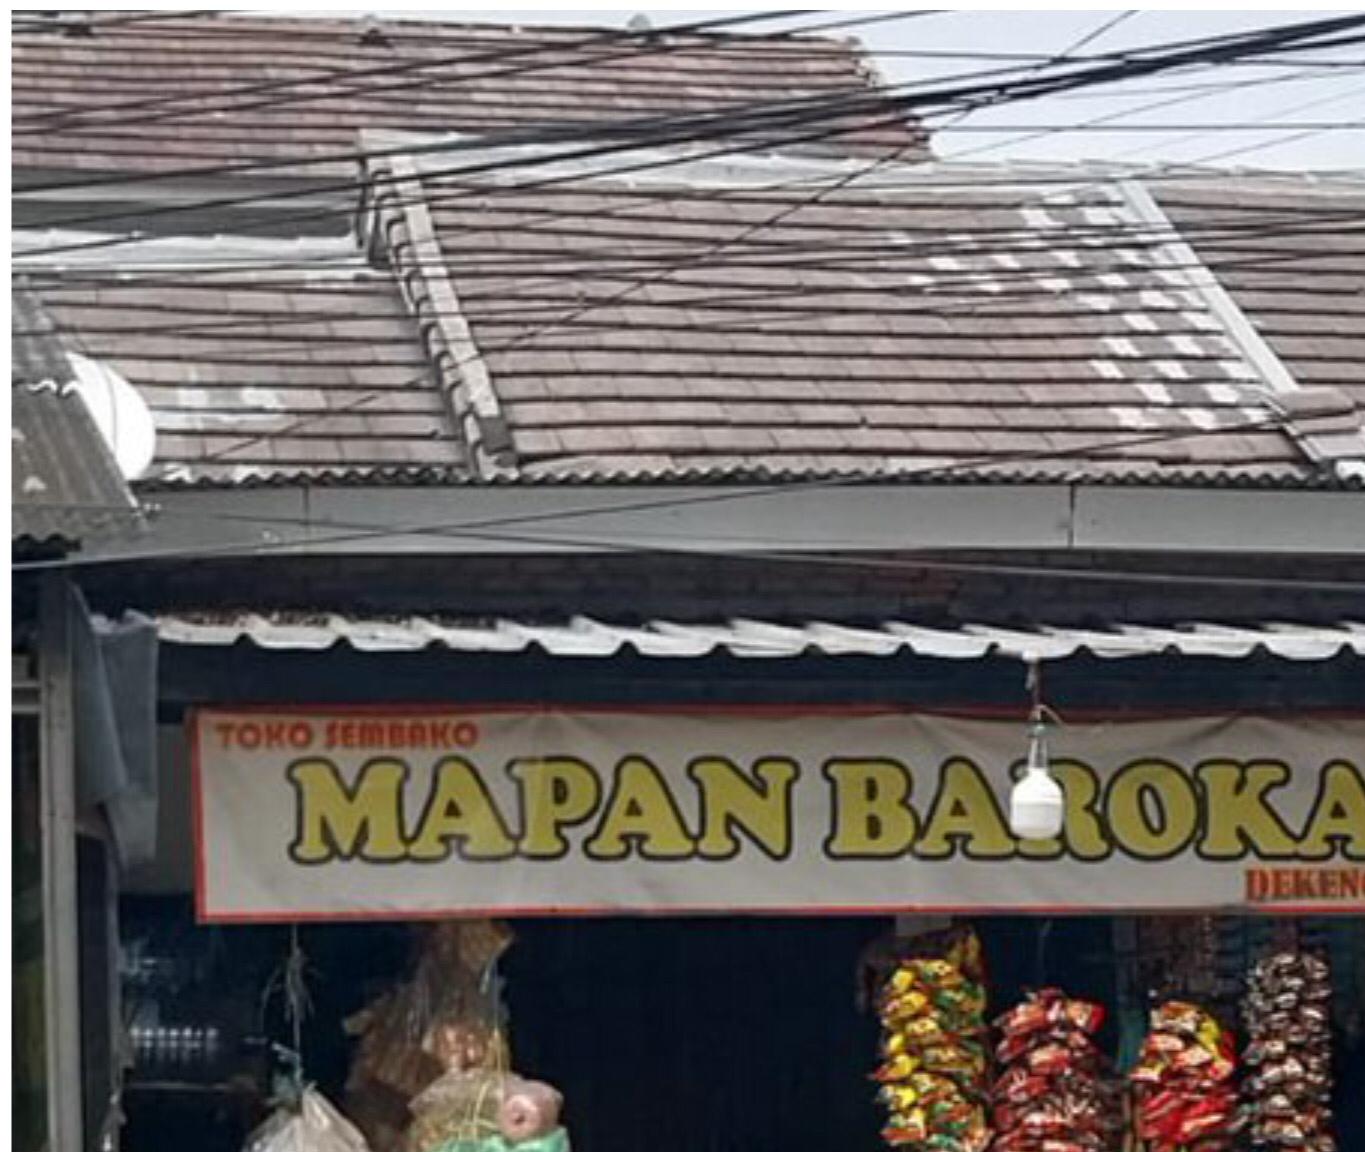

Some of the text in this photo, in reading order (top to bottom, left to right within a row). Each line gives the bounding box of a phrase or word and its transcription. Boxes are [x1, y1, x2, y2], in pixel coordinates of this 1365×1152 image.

[214, 720, 478, 750] TOKO SEMBAKO
[287, 754, 801, 865] MAPAN
